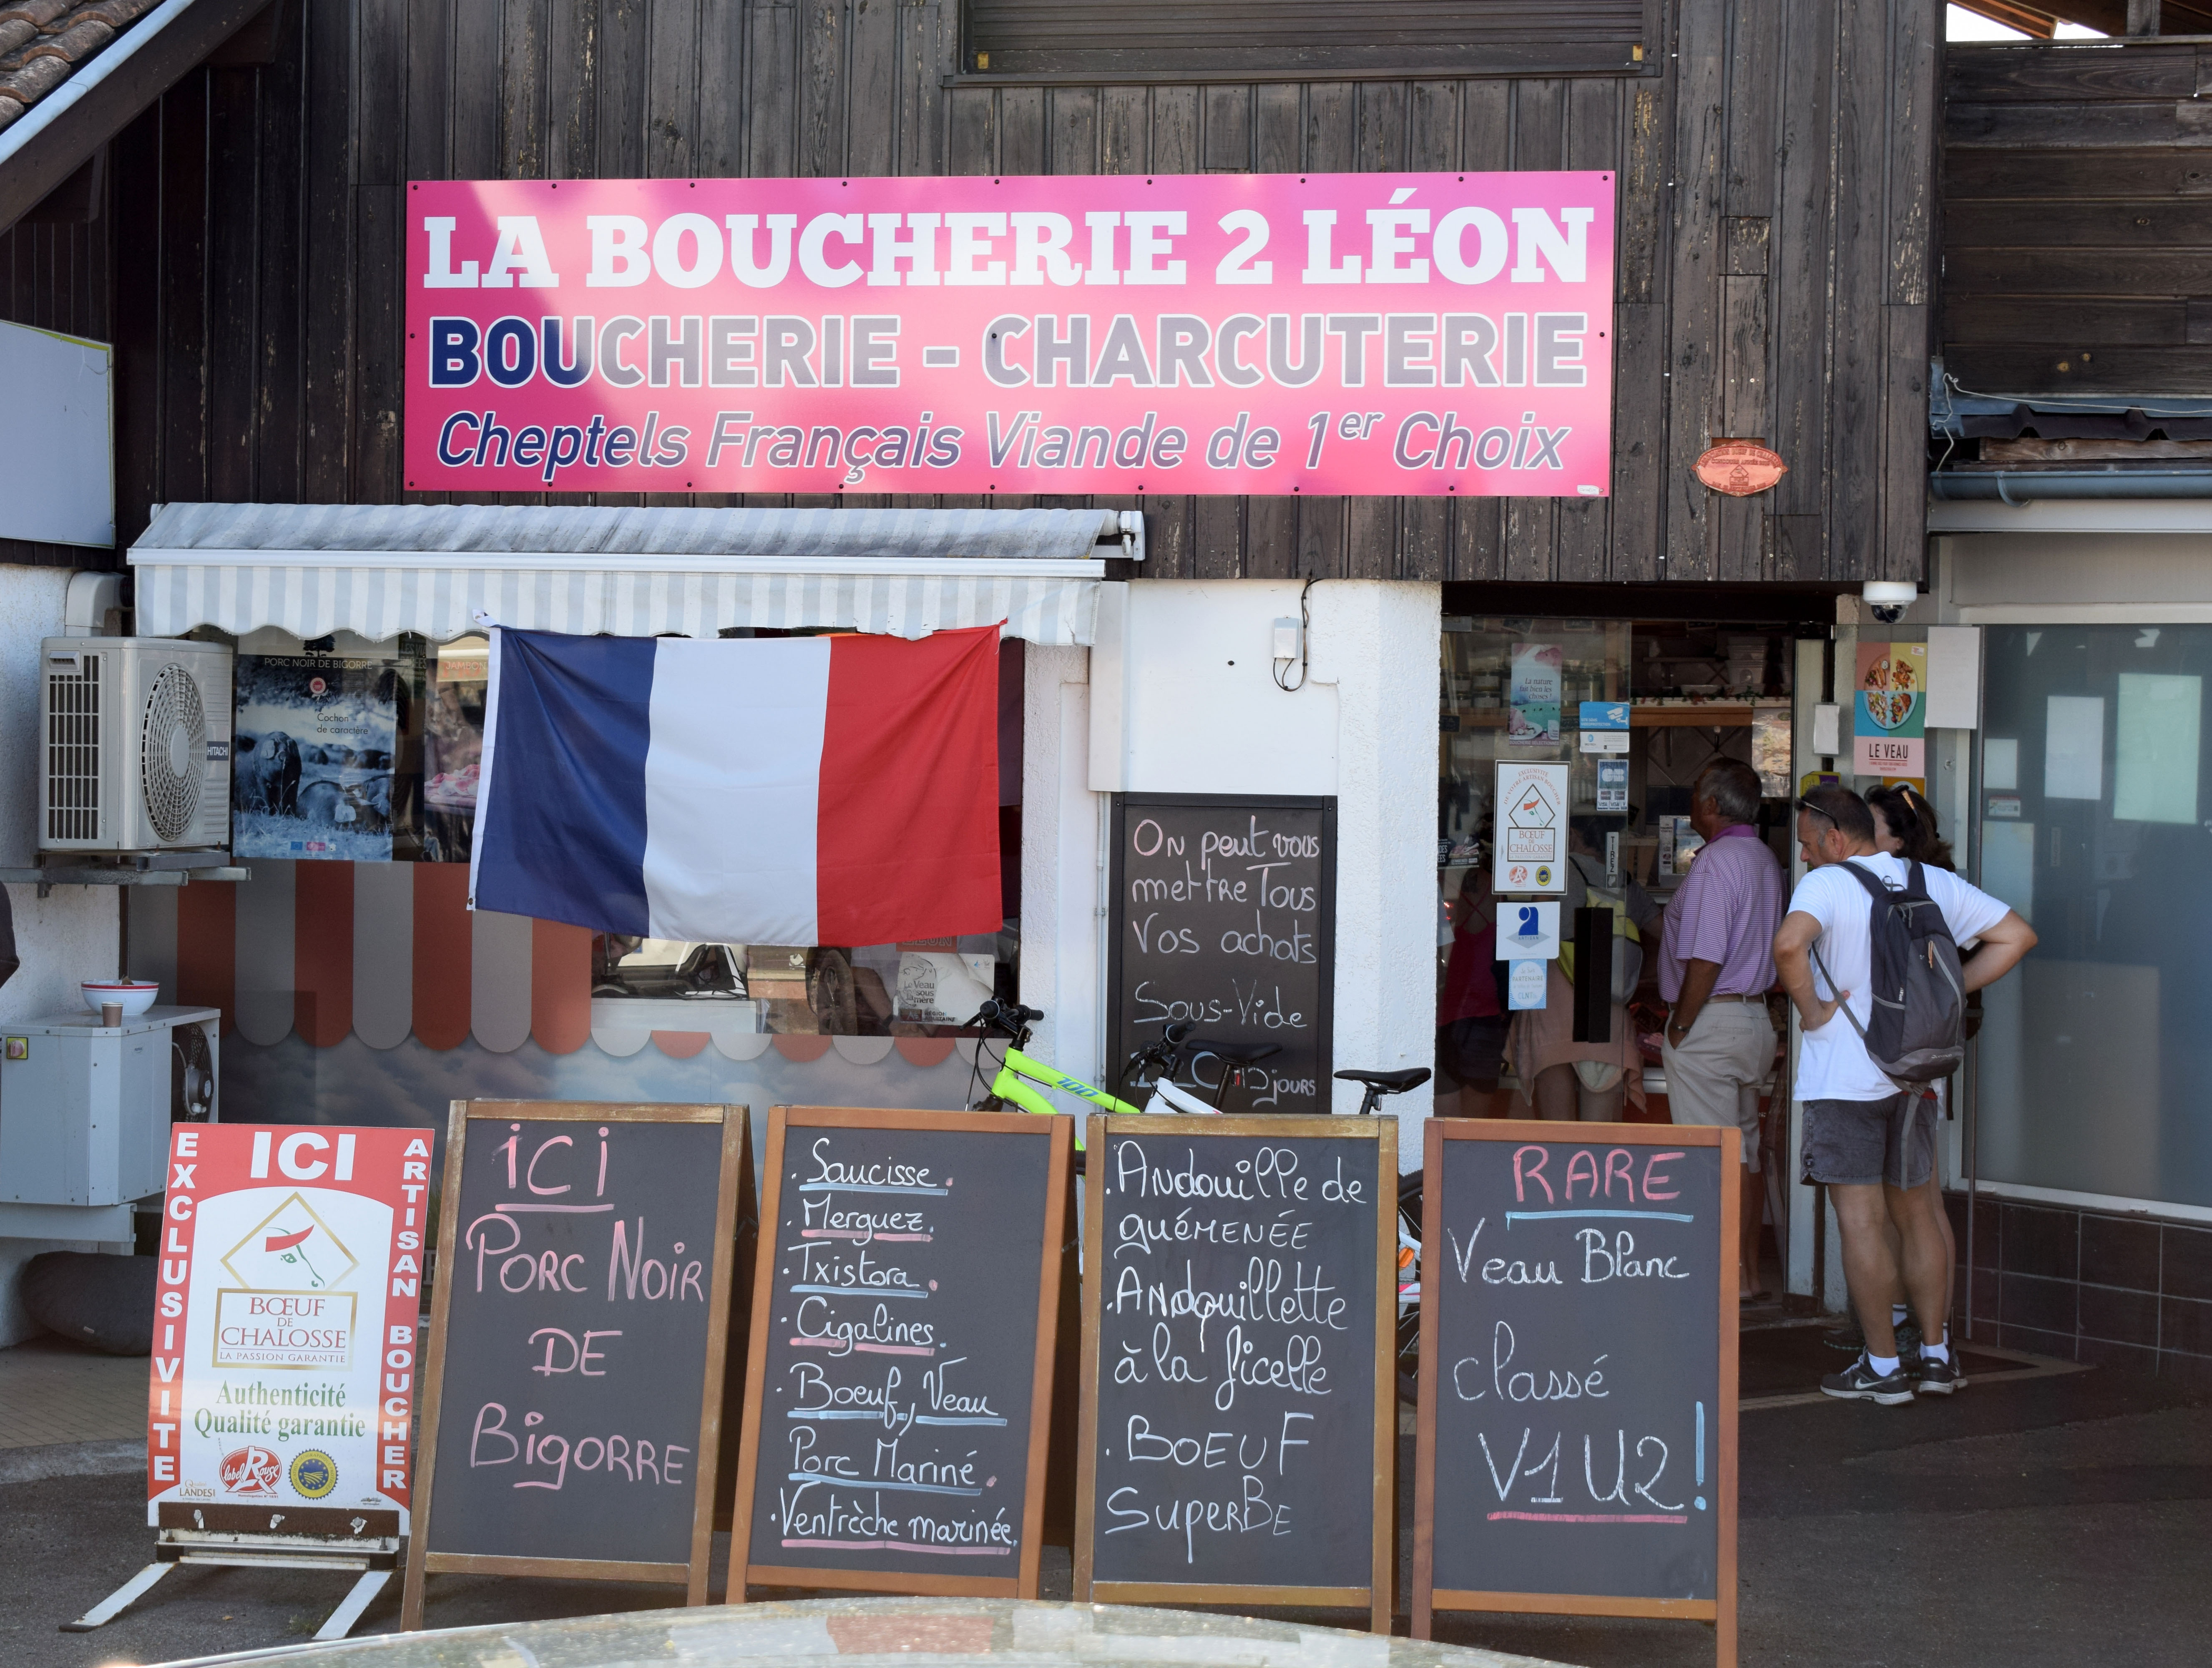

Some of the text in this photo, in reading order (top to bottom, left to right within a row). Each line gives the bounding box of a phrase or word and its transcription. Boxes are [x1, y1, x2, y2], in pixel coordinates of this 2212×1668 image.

[423, 188, 1594, 289] LA BOUCHERIE 2 LÉON
[429, 315, 901, 388] BOUCHERIE
[982, 312, 1587, 388] CHARCUTERIE
[437, 410, 691, 483] Cheptels
[706, 410, 965, 485] Français
[986, 410, 1187, 470] Viande
[1206, 411, 1280, 470] de
[1393, 410, 1572, 471] Choix
[264, 658, 372, 670] PORC NOIR DE BIGORRE
[446, 661, 487, 670] JAMBON
[317, 713, 349, 722] Cochon
[317, 724, 368, 735] de caractère
[208, 746, 228, 756] HITACHI
[1869, 744, 1908, 759] LE VEAU
[1508, 778, 1522, 795] VOTRE
[1544, 779, 1561, 805] BOUCHER
[1201, 815, 1269, 870] peut
[1272, 833, 1320, 858] vous
[1510, 844, 1552, 853] CHALOSSE
[1246, 862, 1316, 911] Tous
[1133, 909, 1317, 964] Vos achats
[913, 980, 935, 989] Veau
[1057, 1076, 1099, 1097] 100
[250, 1131, 356, 1181] ICI
[807, 1138, 938, 1187] Saucisse
[1322, 1156, 1367, 1203] de
[1512, 1145, 1687, 1203] RARE
[803, 1193, 923, 1246] Merguez
[787, 1241, 920, 1287] Txistora
[1447, 1217, 1691, 1285] Veau Blanc
[153, 1132, 199, 1481] EXCLUSIVITE
[249, 1297, 325, 1316] BŒUF
[277, 1317, 293, 1326] DE
[383, 1138, 429, 1489] ARTISAN BOUCHER
[797, 1296, 934, 1357] Cigalines
[221, 1327, 347, 1348] CHALOSSE
[236, 1352, 283, 1361] PASSION
[288, 1354, 346, 1363] GARANTIE
[528, 1327, 623, 1377] DE
[923, 1357, 998, 1416] Veau
[1114, 1321, 1332, 1411] à la ficelle
[216, 1380, 346, 1407] Authenticité
[194, 1408, 366, 1442] Qualité garantie
[1128, 1410, 1314, 1476] BOEUF
[224, 1463, 245, 1483] label
[789, 1426, 978, 1485] Porc Mariné
[179, 1487, 212, 1497] LANDES
[185, 1479, 207, 1488] Qualité
[780, 1480, 899, 1536] Ventrèche
